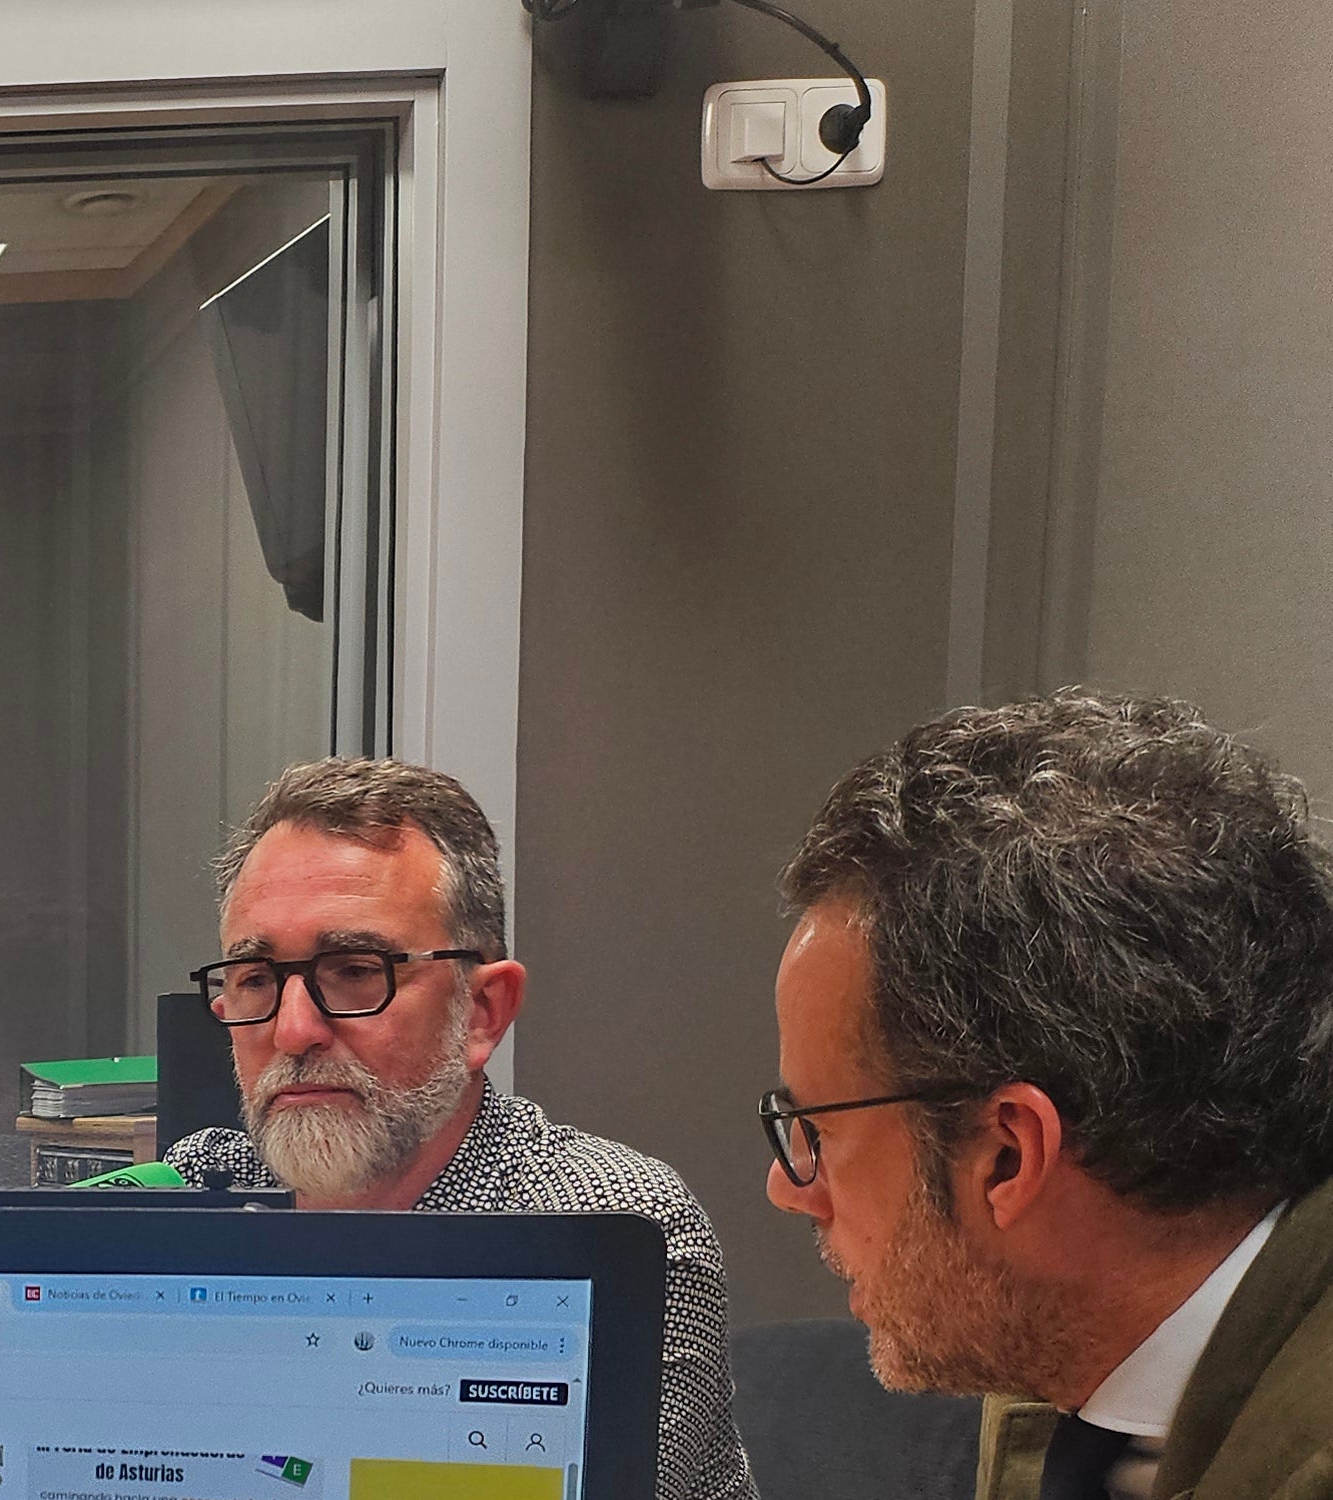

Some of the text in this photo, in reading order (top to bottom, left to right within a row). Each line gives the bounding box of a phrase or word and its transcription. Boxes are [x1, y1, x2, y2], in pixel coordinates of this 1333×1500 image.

[396, 1336, 548, 1352] Nuevo Chrome disponible
[355, 1381, 451, 1396] ¿Quieres más?
[468, 1384, 558, 1401] SUSCRÍBETE
[95, 1462, 184, 1482] de Asturias
